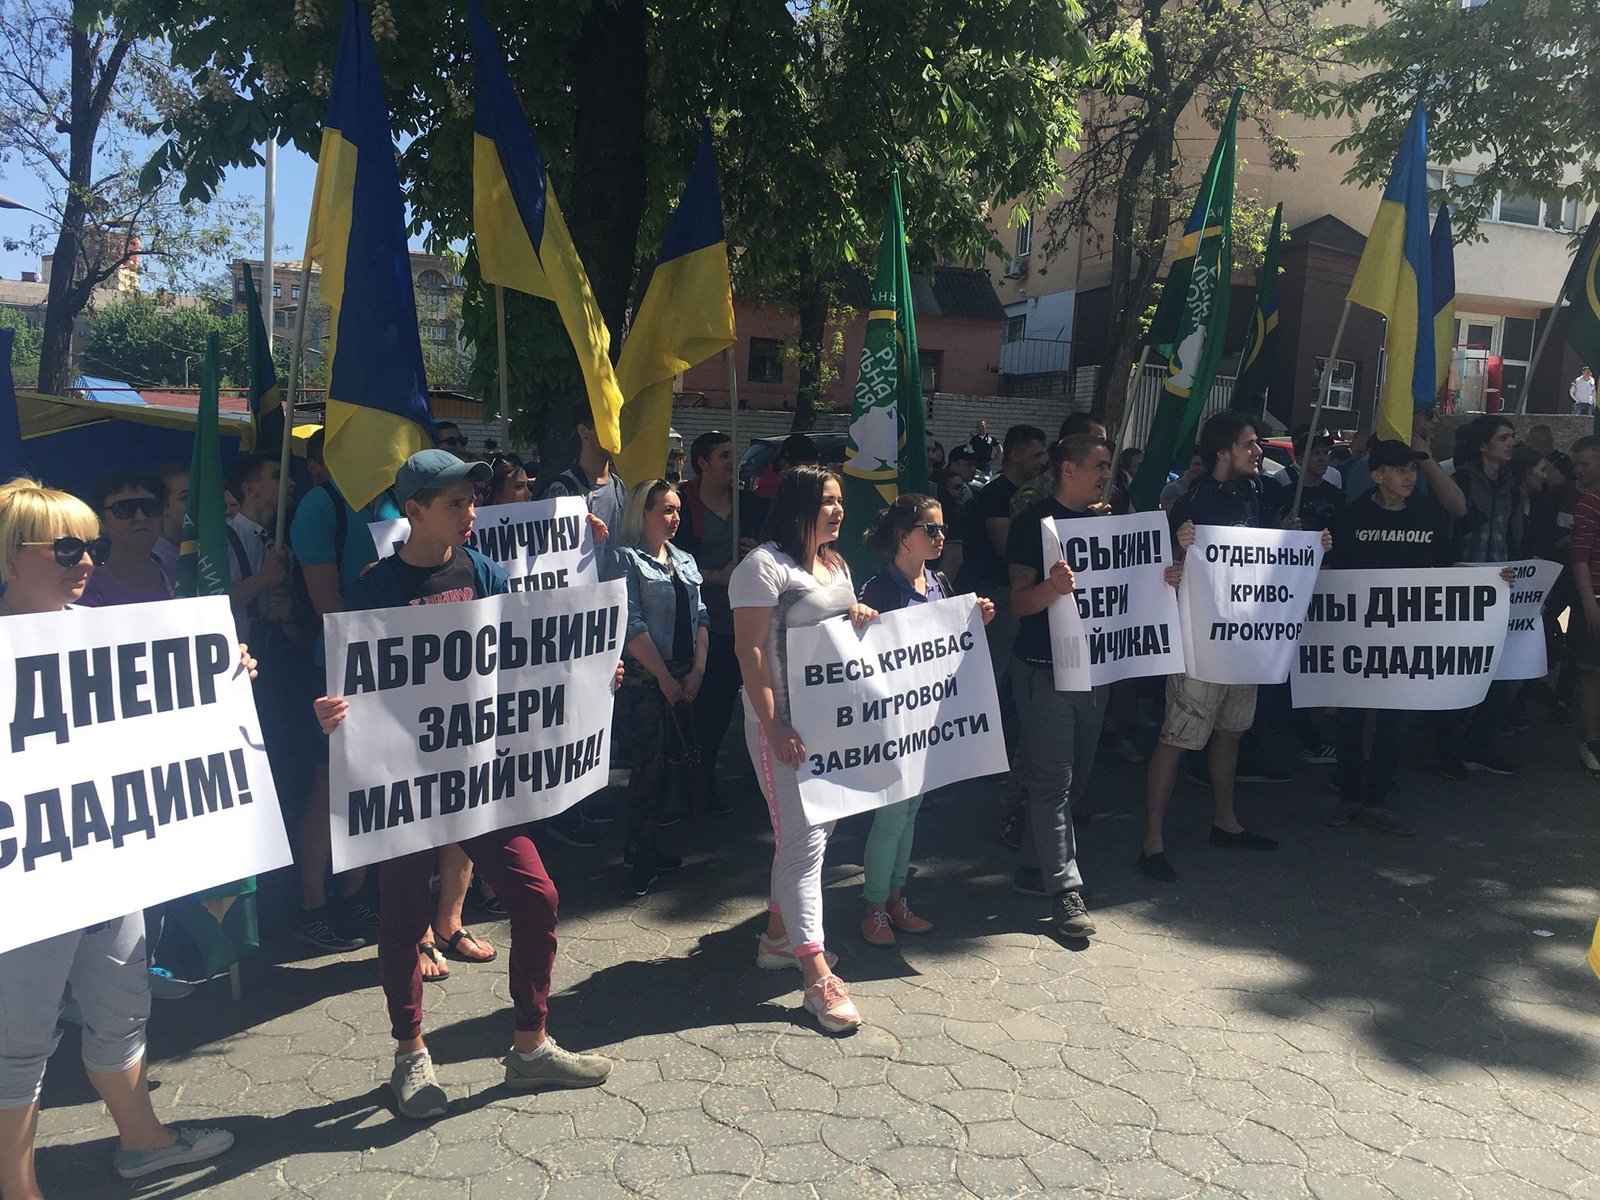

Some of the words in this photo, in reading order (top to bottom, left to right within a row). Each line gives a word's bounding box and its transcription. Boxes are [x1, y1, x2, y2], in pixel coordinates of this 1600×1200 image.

[1206, 544, 1315, 567] ОТДЕЛЬНЫЙ
[1230, 584, 1294, 602] КРИВО-
[1364, 586, 1497, 628] ДНЕПР
[343, 606, 620, 696] АБРОСЬКИН!
[804, 658, 875, 687] ВЕСЬ
[878, 631, 975, 674] КРИВБАС
[1299, 645, 1336, 674] НЕ
[1342, 645, 1495, 680] СДАДИМ!
[9, 633, 231, 753] ДНЕПР
[418, 684, 566, 753] ЗАБЕРИ
[836, 705, 854, 728] В
[862, 674, 958, 723] ИГРОВОЙ
[808, 712, 990, 776] ЗАВИСИМОСТИ
[348, 748, 605, 837] МАТВИЙЧУКА!
